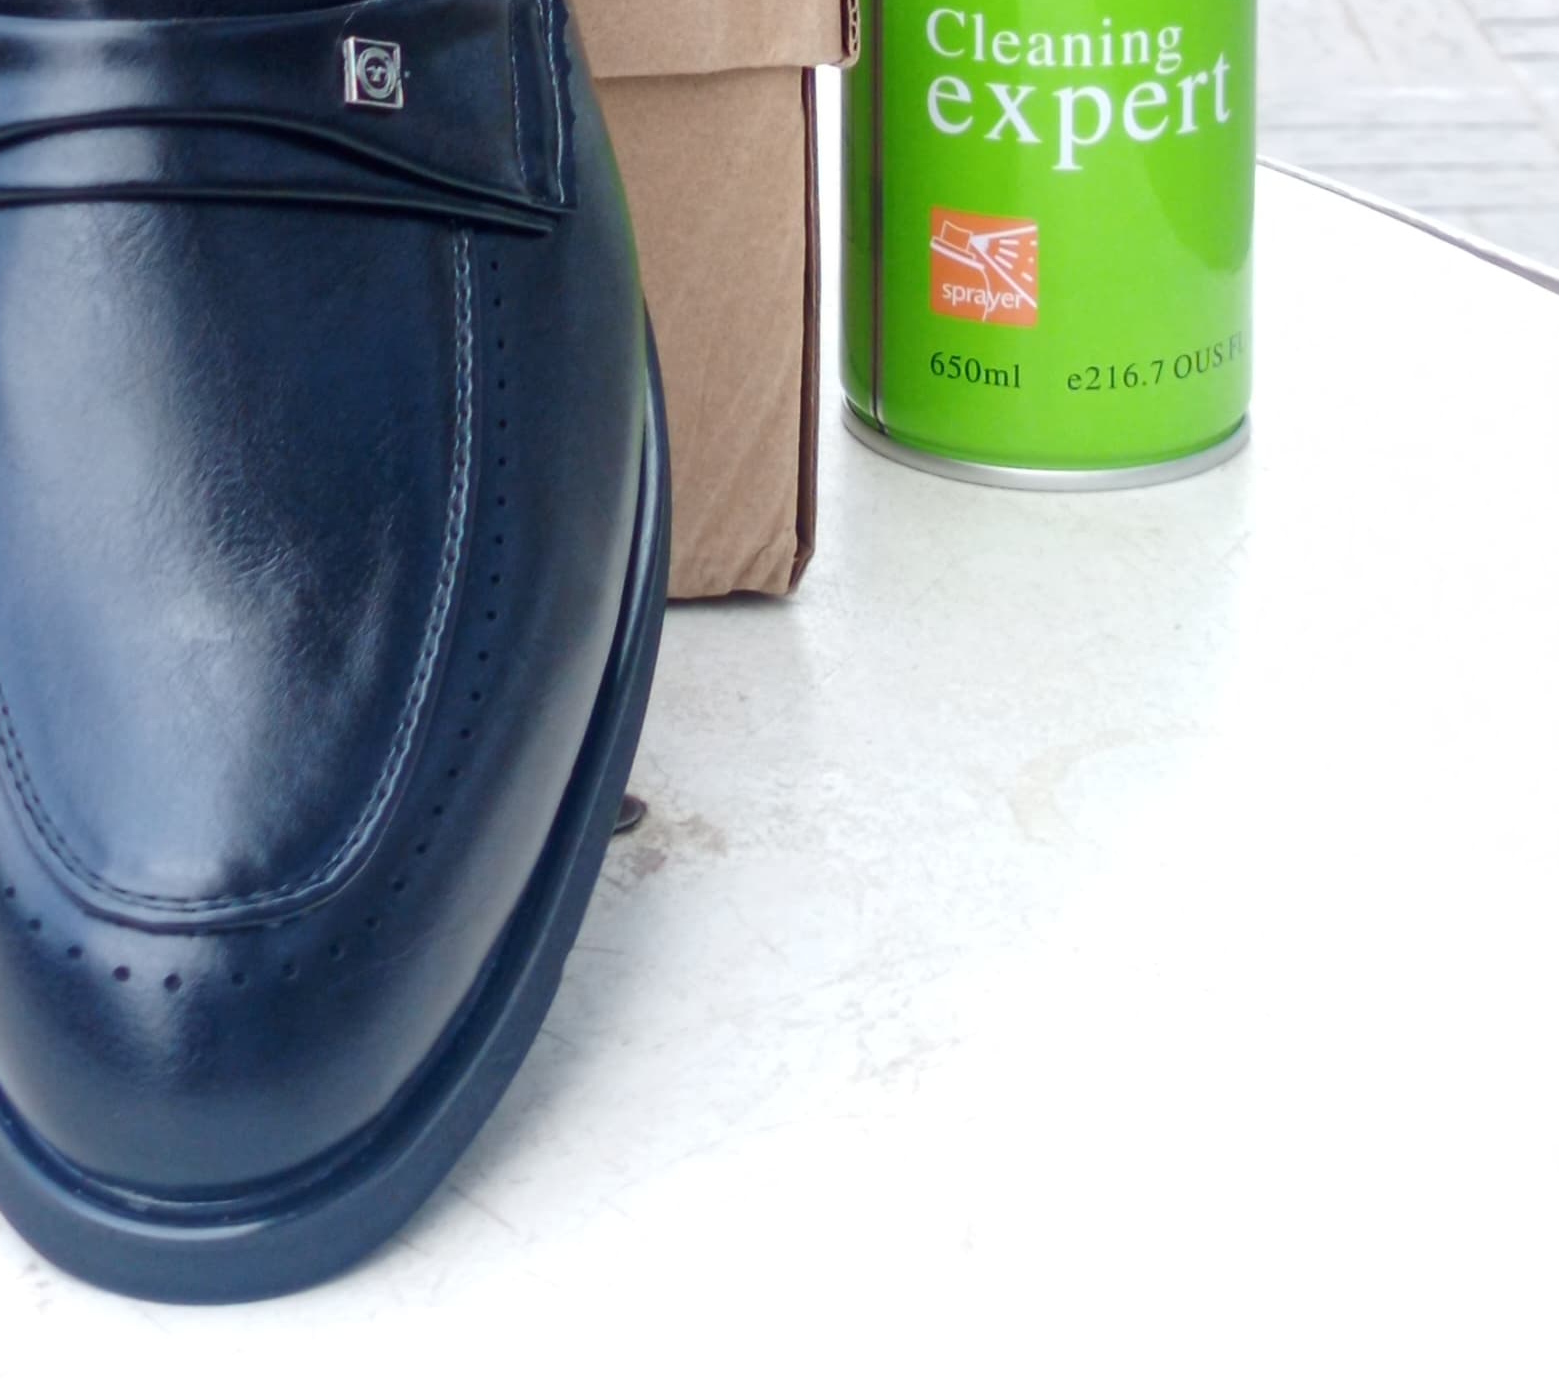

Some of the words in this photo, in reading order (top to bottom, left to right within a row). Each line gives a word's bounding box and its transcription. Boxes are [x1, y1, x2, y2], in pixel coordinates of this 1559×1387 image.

[925, 8, 1184, 74] Cleaning
[925, 52, 1233, 172] expert
[941, 280, 1026, 311] sprayer
[929, 351, 1022, 390] 650ml
